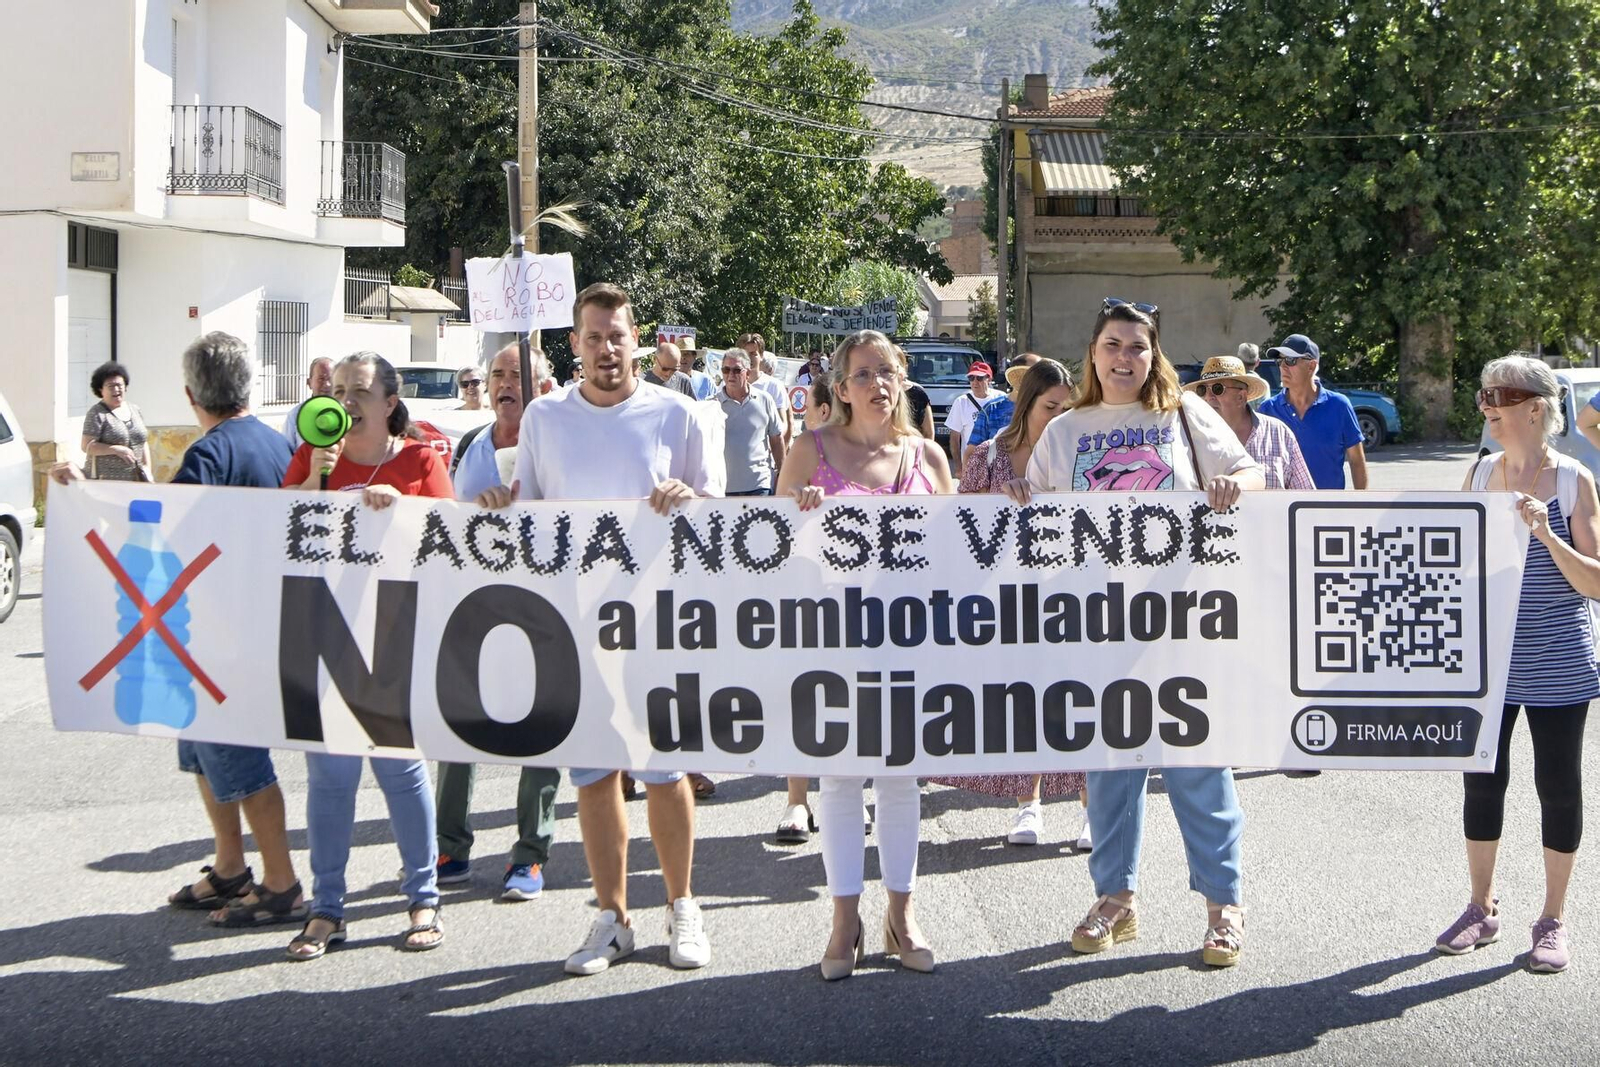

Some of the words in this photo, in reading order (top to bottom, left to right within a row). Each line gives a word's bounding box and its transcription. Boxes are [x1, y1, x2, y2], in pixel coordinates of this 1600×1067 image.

[502, 261, 544, 291] NO
[504, 281, 565, 308] ROBO
[789, 298, 800, 312] EL
[867, 299, 897, 314] VENDE
[473, 308, 505, 324] DEL
[511, 303, 546, 319] AGUA
[822, 317, 837, 330] SE
[841, 315, 892, 331] DEFIENDE
[1077, 425, 1175, 453] STONES
[286, 500, 384, 567] EL
[411, 508, 642, 578] AGUA
[669, 506, 795, 576] NO
[820, 504, 931, 573] SE
[954, 501, 1242, 570] VENDE
[598, 600, 636, 650] a
[656, 590, 717, 650] la
[736, 582, 1239, 649] embotelladora
[279, 575, 582, 758] NO
[646, 673, 764, 754] de
[791, 670, 1210, 767] Cijancos
[1347, 723, 1408, 742] FIRMA
[1412, 720, 1463, 744] AQUÍ
